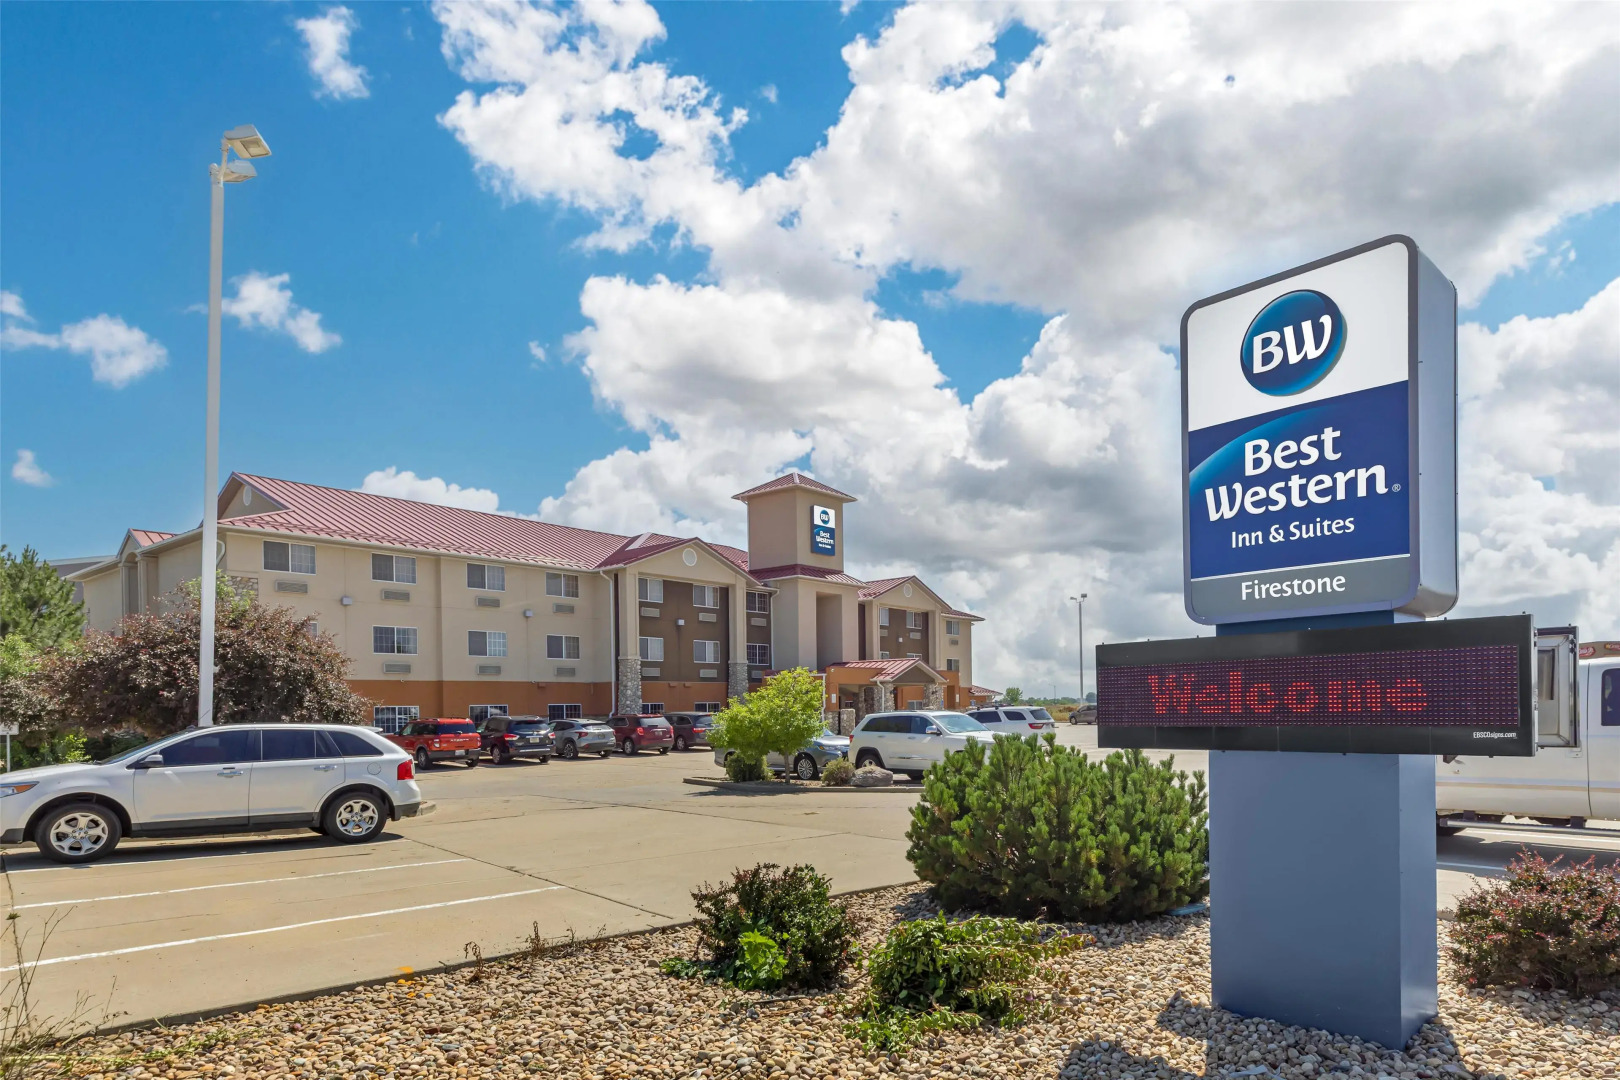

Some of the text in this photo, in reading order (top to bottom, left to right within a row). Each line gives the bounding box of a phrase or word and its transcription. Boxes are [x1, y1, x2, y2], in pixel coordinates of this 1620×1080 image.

[1252, 314, 1332, 374] BW
[1244, 426, 1342, 477] Best
[1204, 464, 1389, 522] Western
[1231, 517, 1355, 549] Inn & Suites
[1241, 575, 1346, 601] Firestone
[1148, 671, 1427, 713] Welcome
